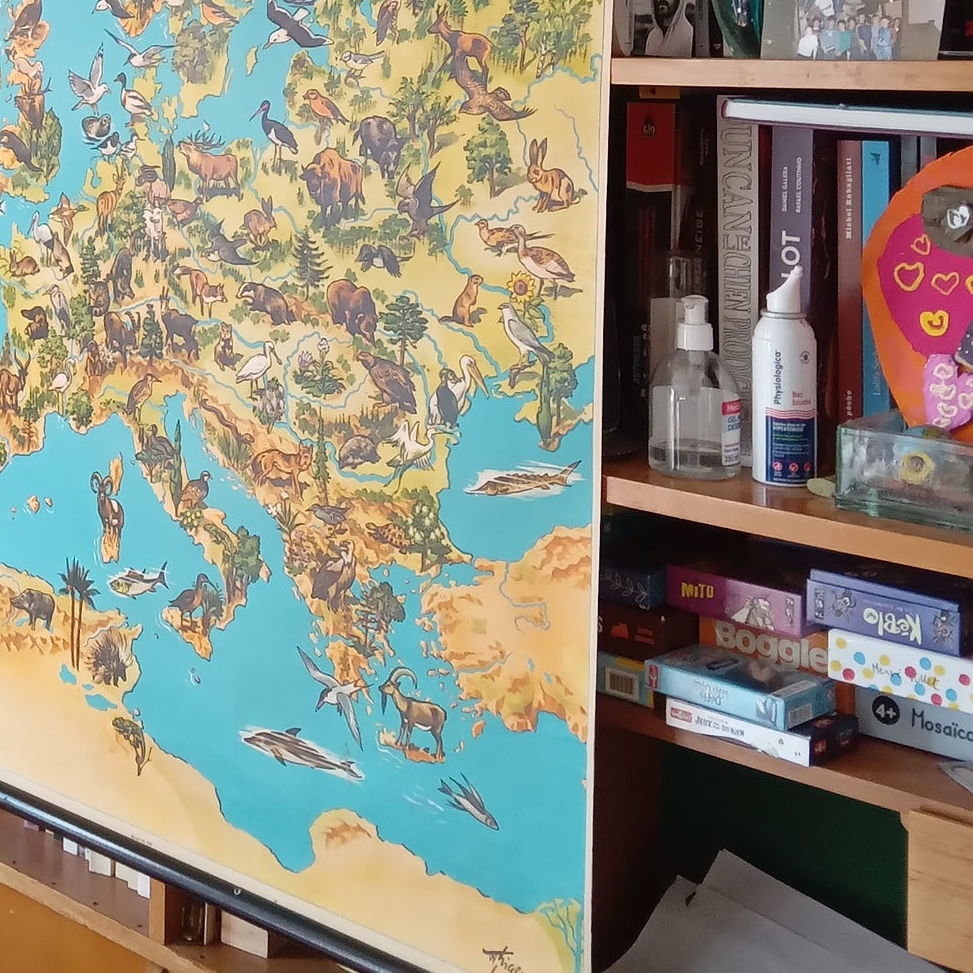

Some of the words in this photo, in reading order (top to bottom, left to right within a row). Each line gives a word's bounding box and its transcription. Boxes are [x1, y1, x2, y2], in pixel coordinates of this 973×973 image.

[721, 124, 753, 234] UNCAN
[795, 157, 803, 190] COUTINHO
[844, 157, 853, 207] Rabagliati
[781, 191, 789, 212] DANIEL
[845, 208, 853, 240] Michel
[722, 252, 753, 313] CHIEN
[773, 351, 784, 405] Physiologica
[714, 619, 828, 675] Boggle
[875, 703, 897, 720] 4+
